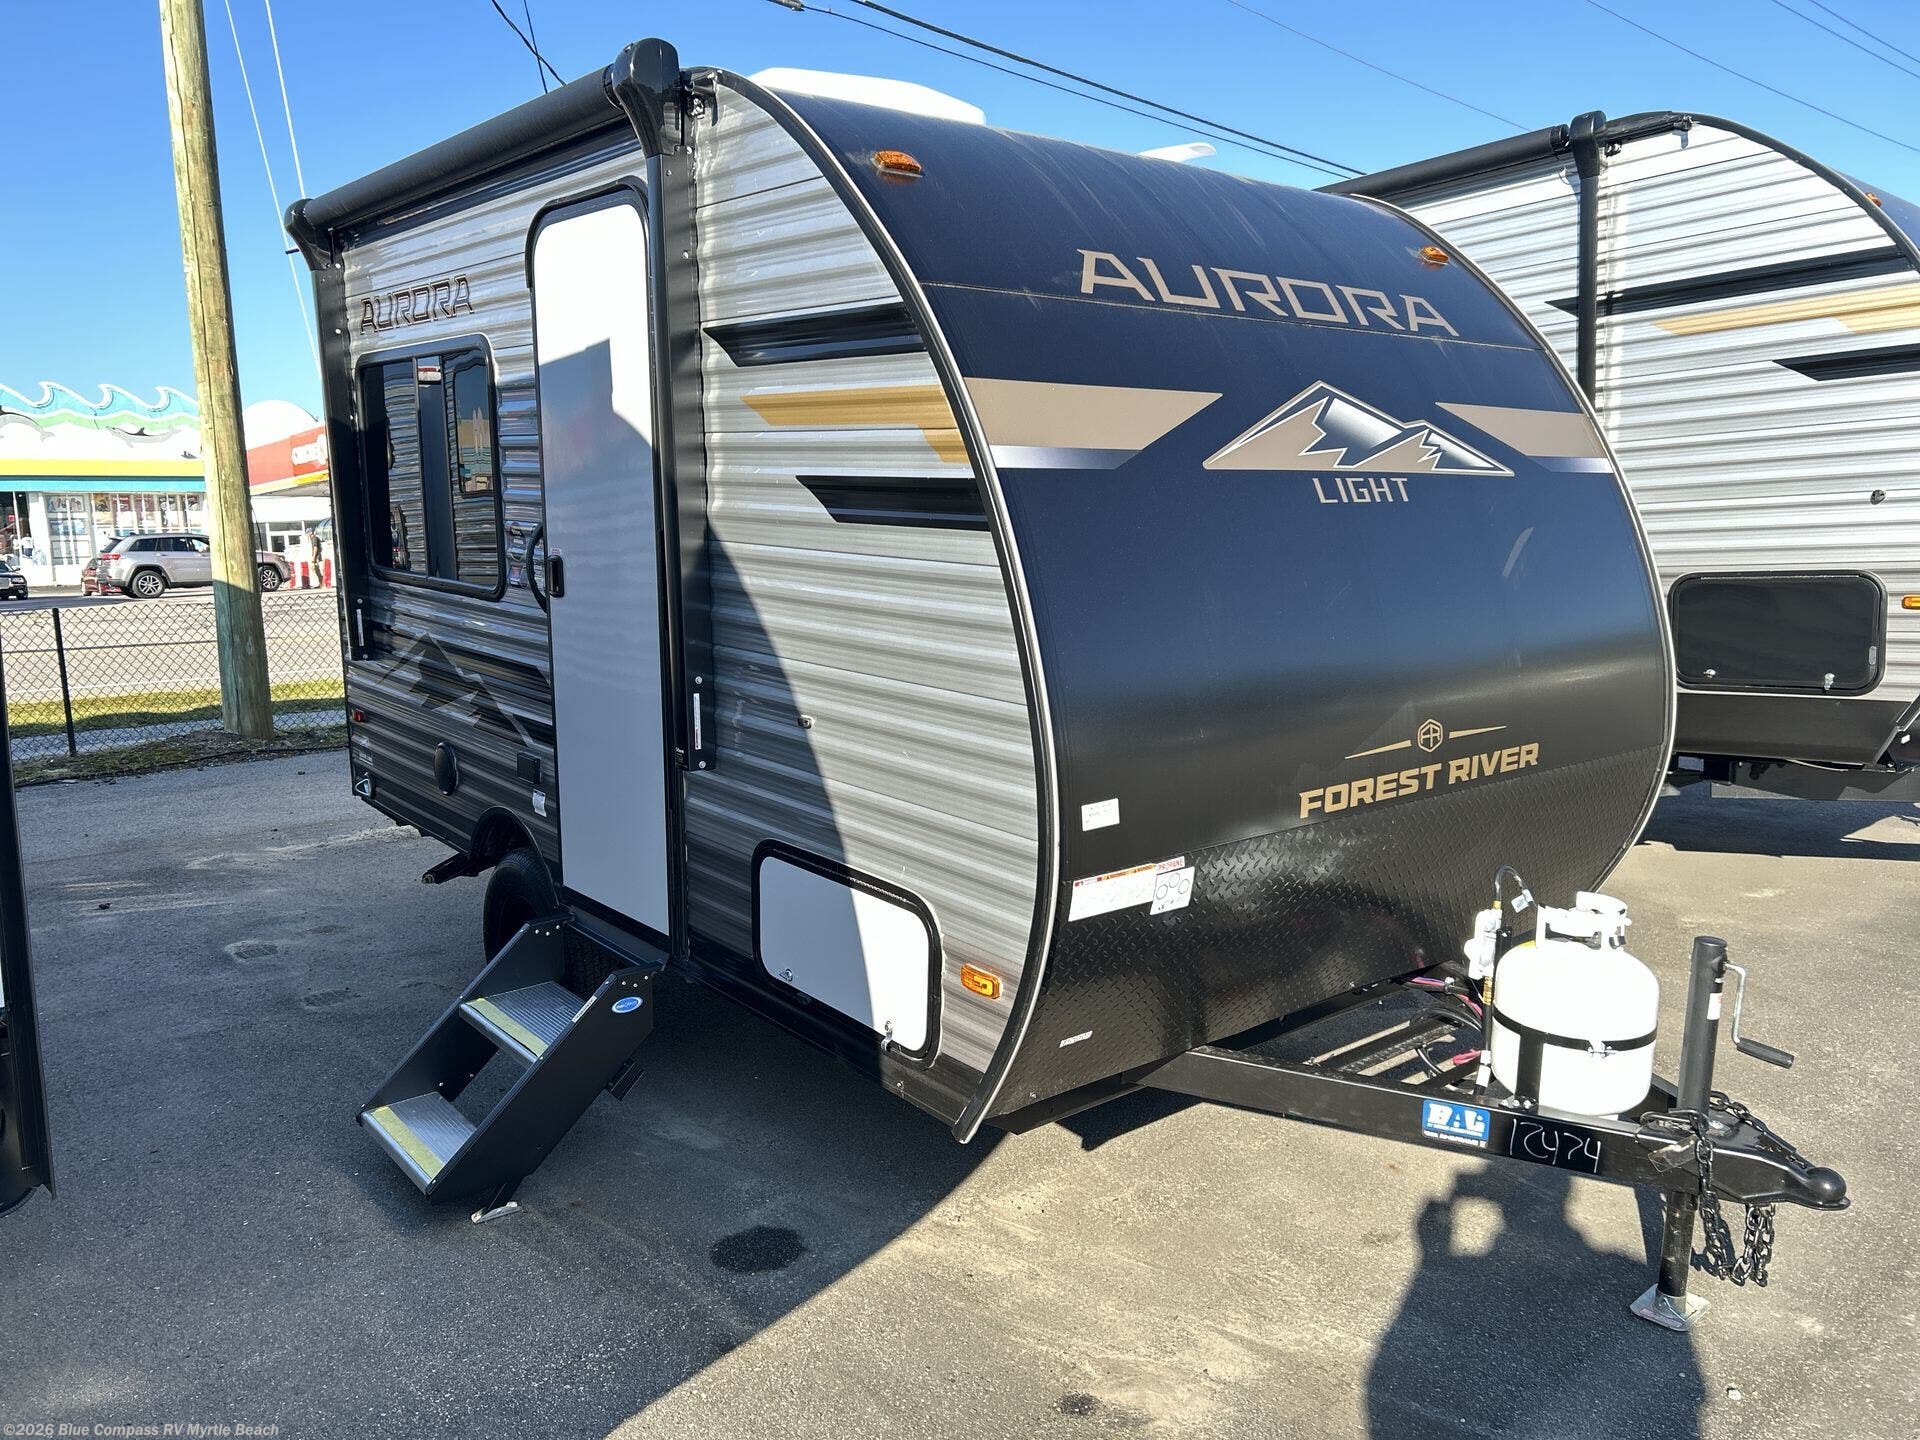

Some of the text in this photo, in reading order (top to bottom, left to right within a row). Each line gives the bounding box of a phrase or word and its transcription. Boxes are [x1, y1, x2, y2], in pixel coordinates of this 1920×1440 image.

[360, 274, 475, 335] AURORA
[1076, 248, 1460, 337] AURORA
[1312, 477, 1411, 504] LIGHT
[1298, 742, 1540, 819] FOREST RIVER
